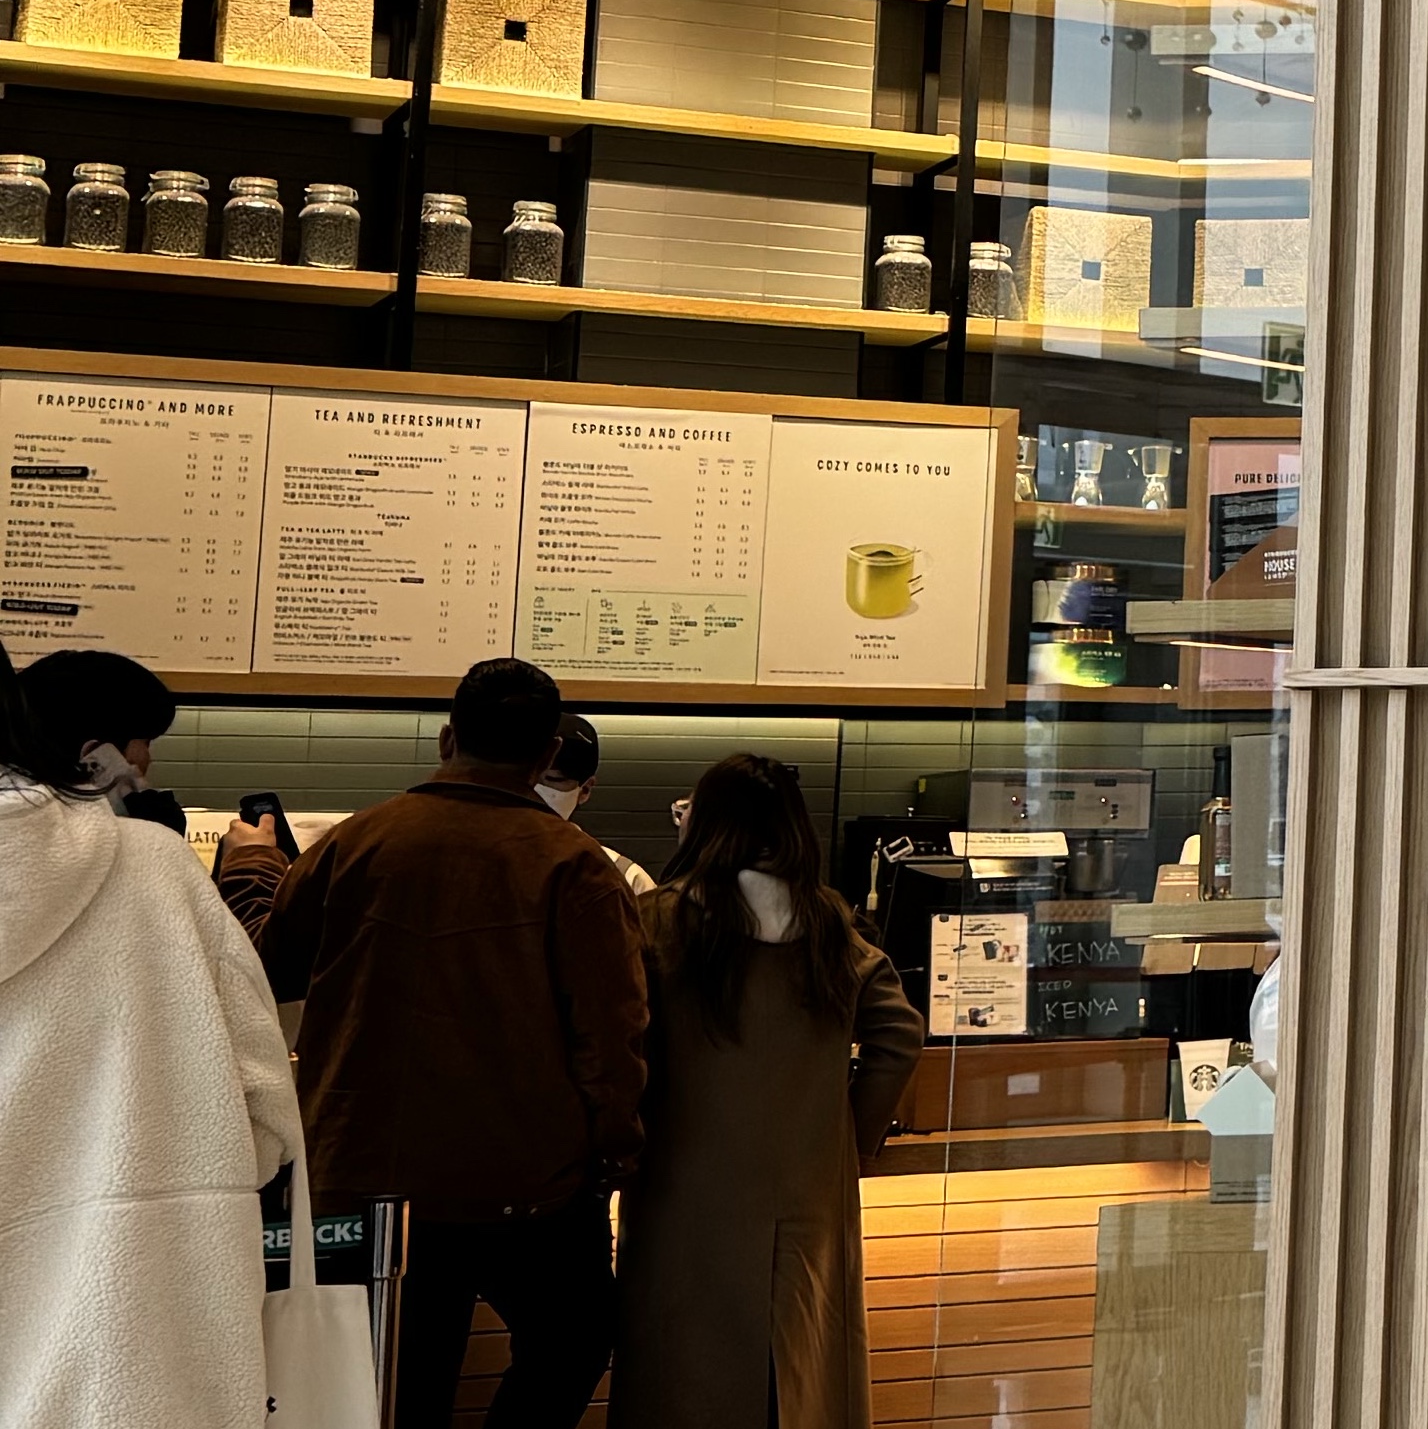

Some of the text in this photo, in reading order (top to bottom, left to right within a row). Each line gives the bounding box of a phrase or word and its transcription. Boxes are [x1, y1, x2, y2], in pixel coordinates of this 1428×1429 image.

[157, 401, 188, 414] AND
[195, 403, 236, 416] MORE
[315, 409, 482, 430] TEA AND REFRESHMENT
[572, 422, 732, 442] ESPRESSO AND COFFEE
[817, 460, 951, 476] COZY COMES TO YOU
[1234, 473, 1262, 484] PURE
[1264, 557, 1295, 573] HOUSE
[187, 831, 220, 844] LATO
[1046, 940, 1121, 967] KENYA
[1038, 980, 1072, 992] ICED
[1045, 997, 1119, 1022] KENYA
[263, 1221, 363, 1249] RBCKS
